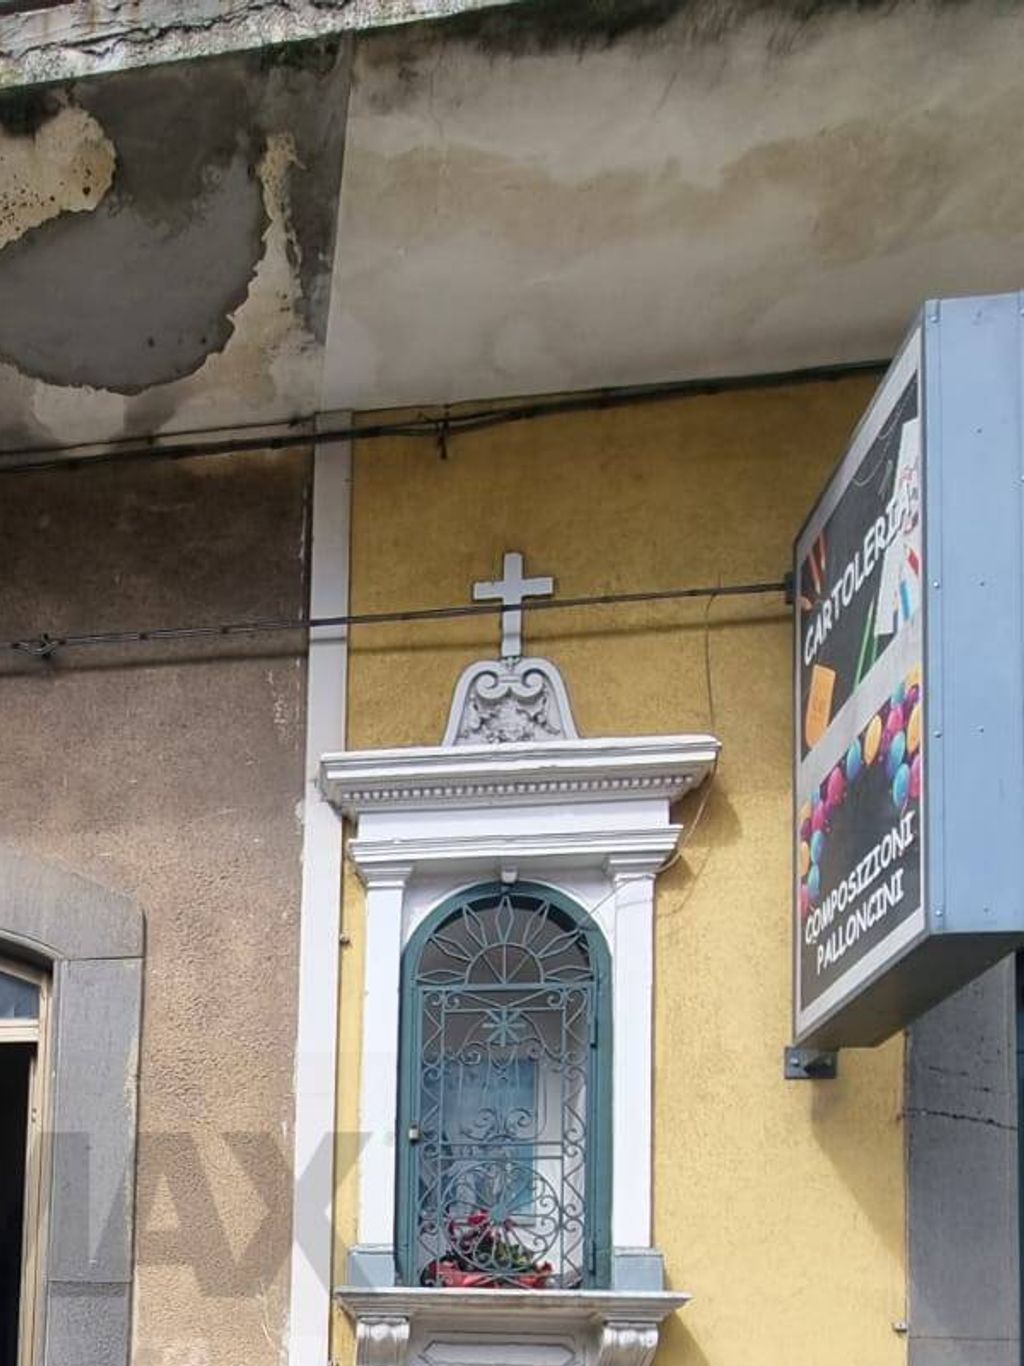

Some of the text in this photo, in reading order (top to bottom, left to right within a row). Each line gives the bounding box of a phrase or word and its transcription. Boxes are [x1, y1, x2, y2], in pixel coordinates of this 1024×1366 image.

[804, 483, 911, 666] CARTOLERIA
[805, 811, 915, 944] COMPOSIZIONI
[816, 868, 904, 975] PALLONCINI
